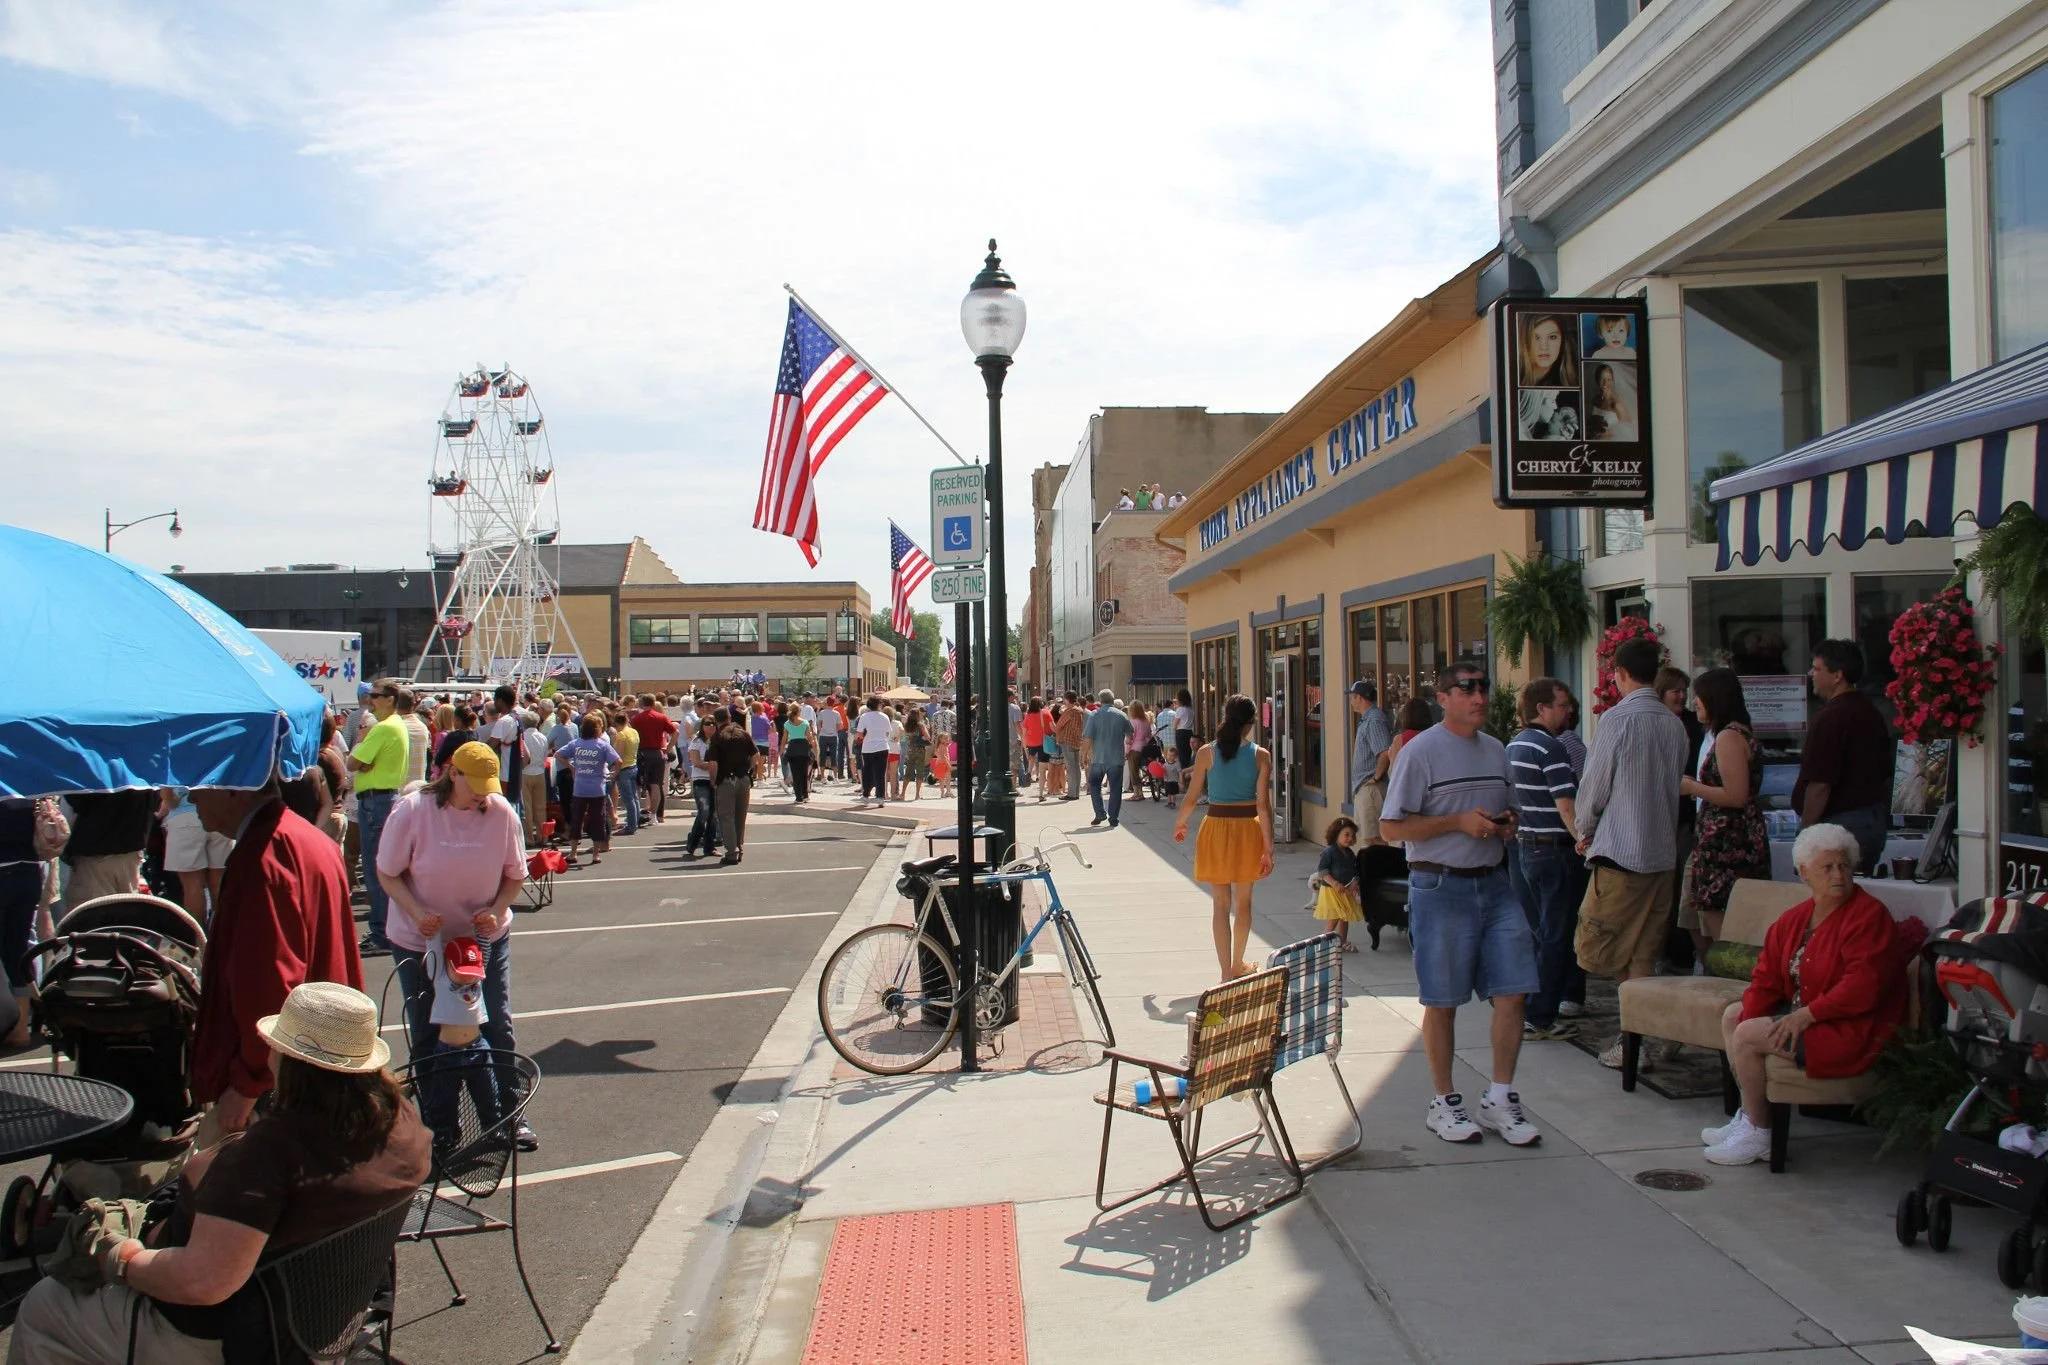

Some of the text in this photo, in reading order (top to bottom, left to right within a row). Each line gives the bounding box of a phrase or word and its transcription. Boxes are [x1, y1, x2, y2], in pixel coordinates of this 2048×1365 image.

[1199, 376, 1417, 552] TRONE APPLIANCE CENTER
[1517, 460, 1642, 474] CHERYL KELLY
[934, 475, 980, 491] RESERVED
[1592, 478, 1642, 488] photography
[937, 493, 978, 508] PARKING
[964, 575, 984, 594] FINE
